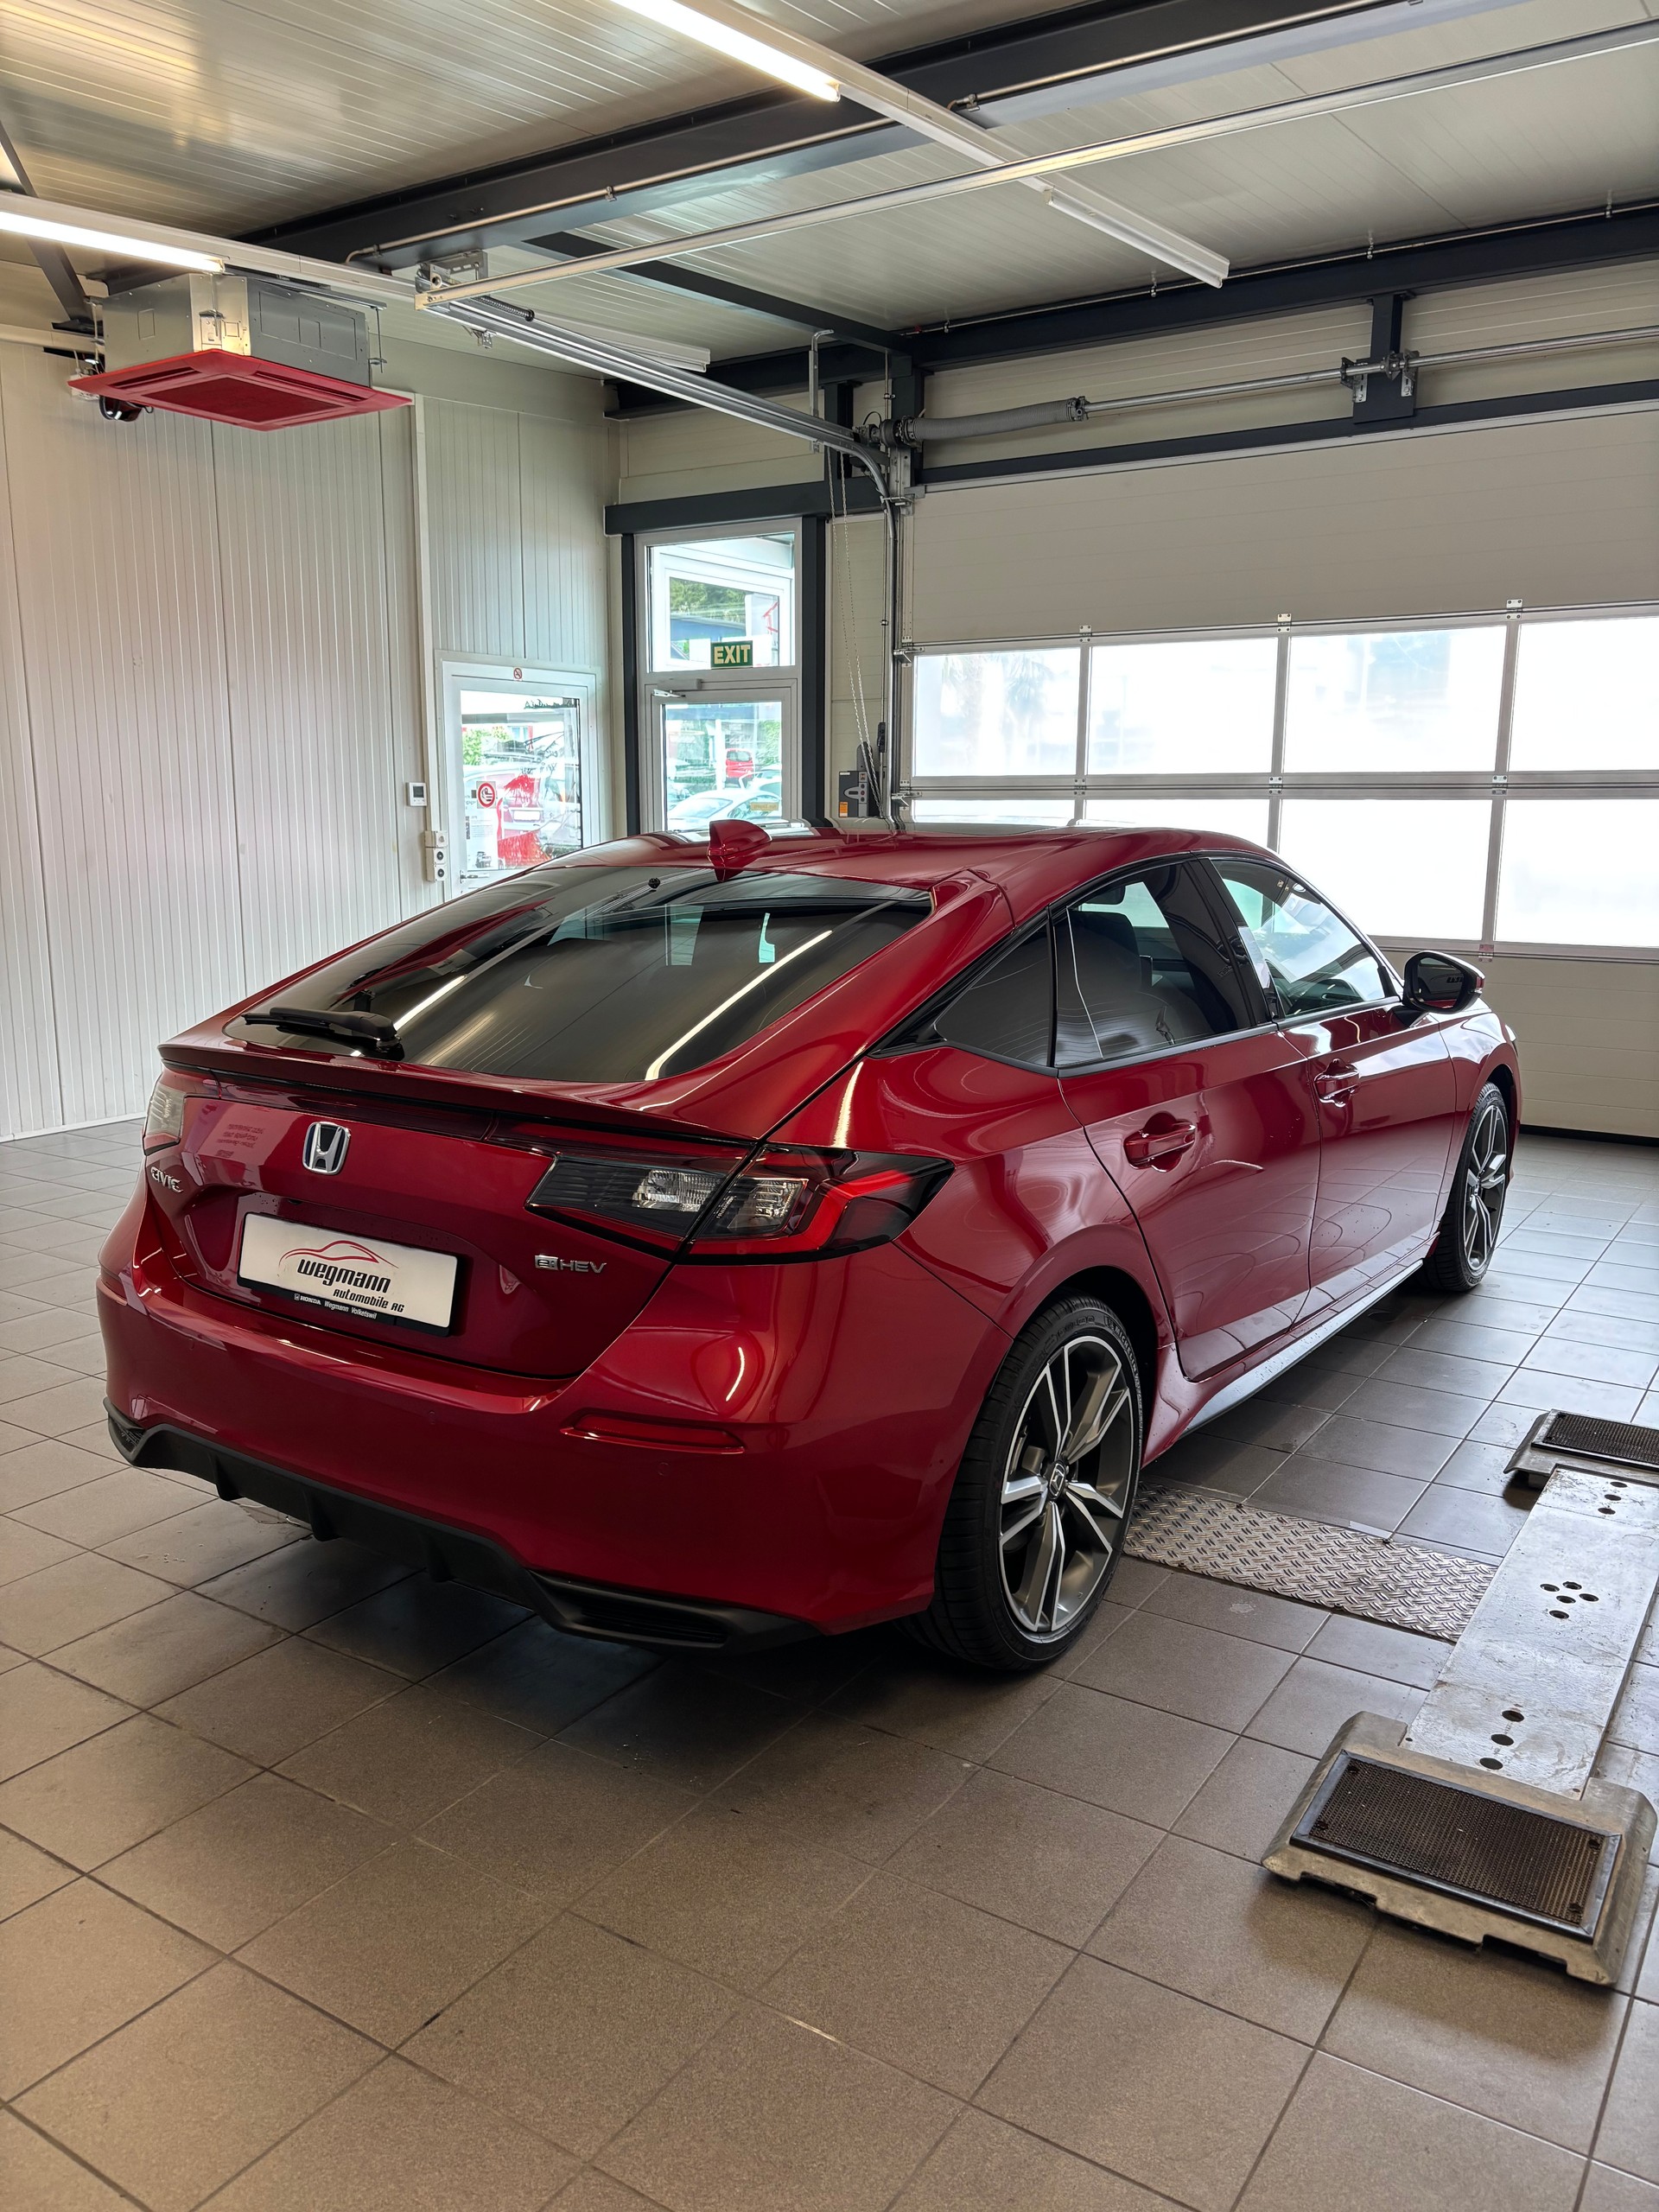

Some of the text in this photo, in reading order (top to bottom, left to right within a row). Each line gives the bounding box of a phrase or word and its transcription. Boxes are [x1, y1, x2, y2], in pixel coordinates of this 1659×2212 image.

[714, 645, 751, 664] EXIT
[150, 1166, 183, 1192] CIVIC
[297, 1259, 391, 1294] wegmann
[300, 1295, 321, 1306] HONDA
[324, 1300, 349, 1313] Wegmann
[391, 1302, 405, 1313] AG
[1115, 1325, 1137, 1372] MICHELIN
